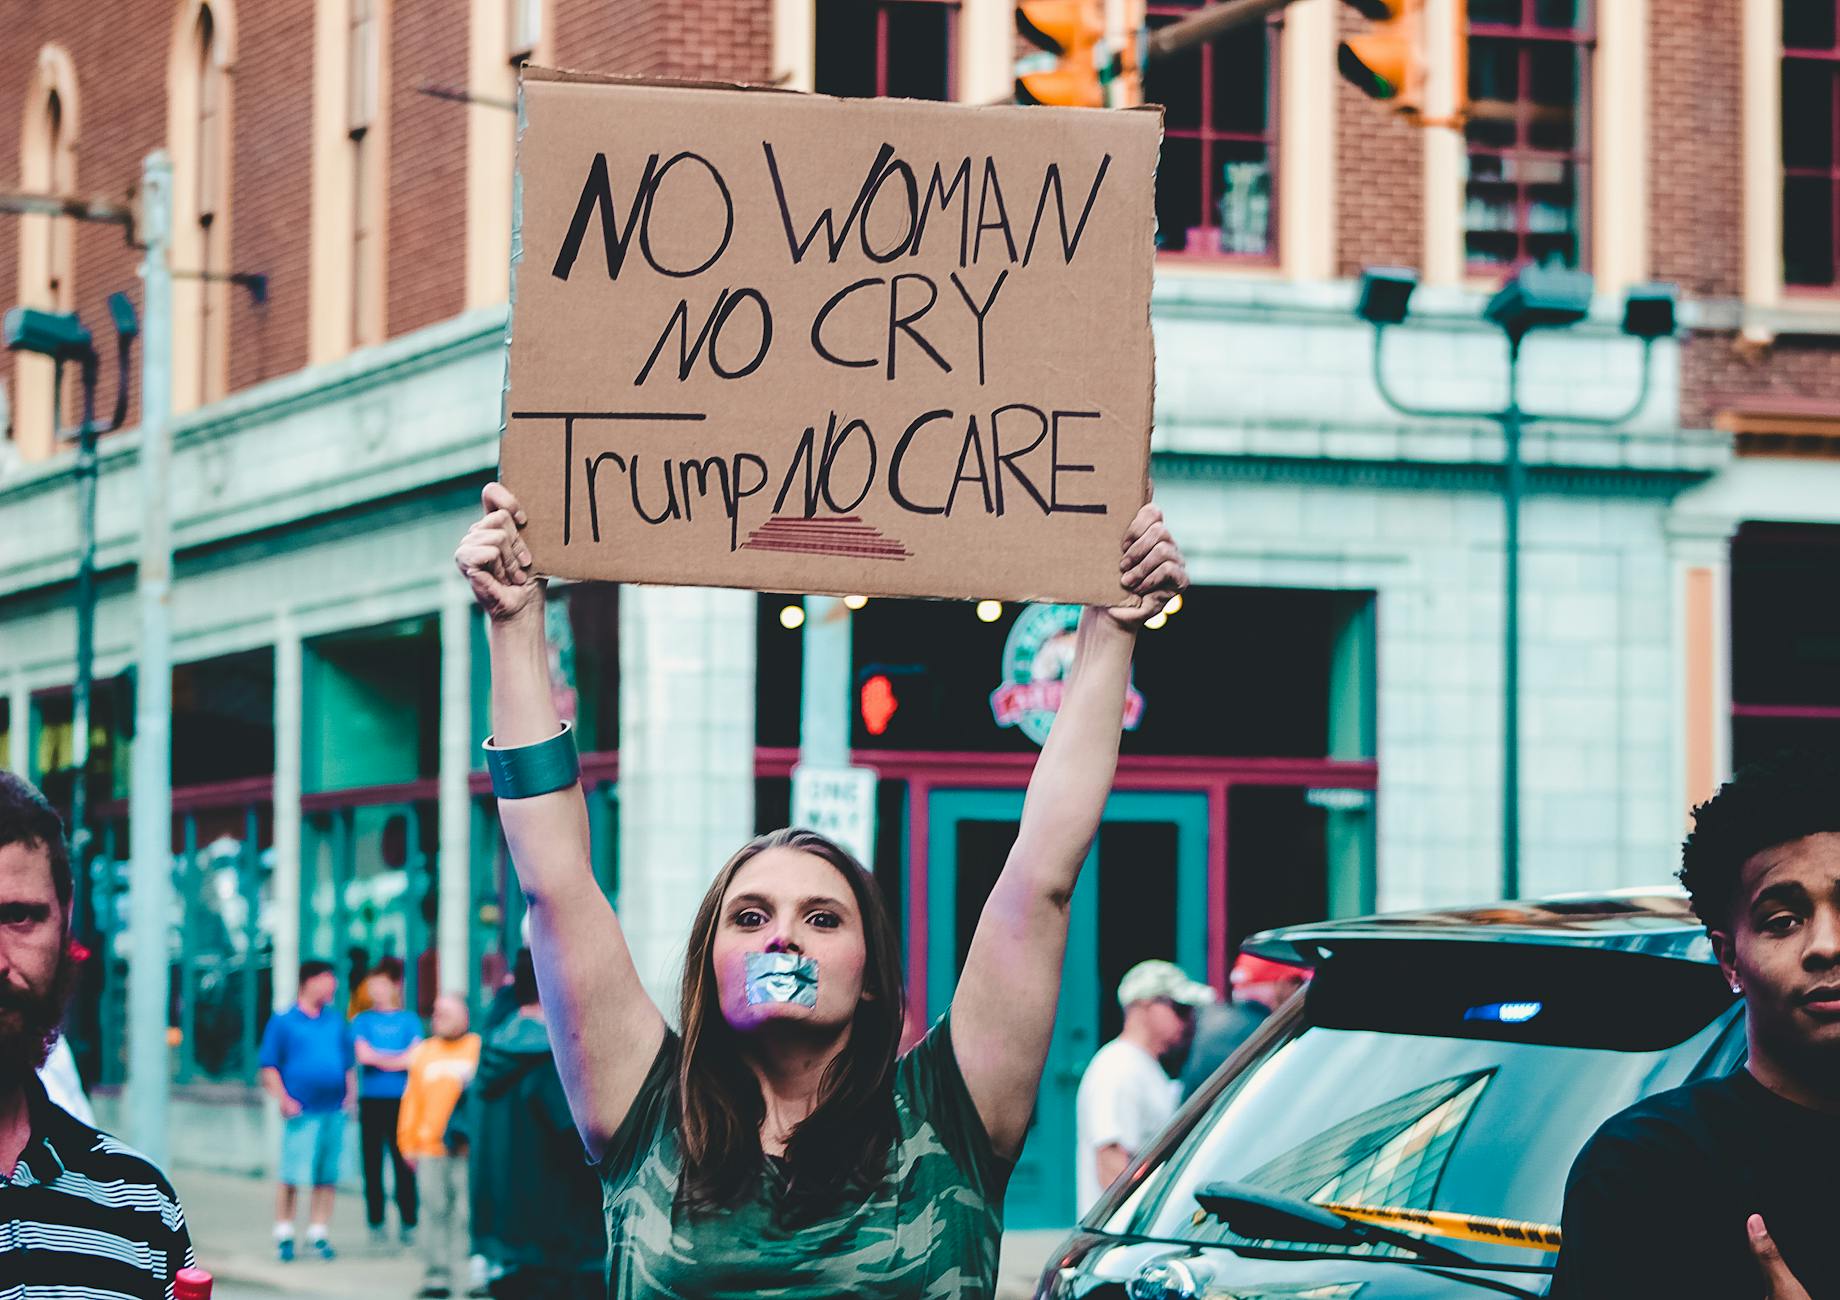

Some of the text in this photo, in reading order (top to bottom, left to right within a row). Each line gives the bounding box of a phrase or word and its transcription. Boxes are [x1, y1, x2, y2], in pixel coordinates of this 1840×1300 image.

[552, 140, 1111, 281] NO WOMAN
[633, 270, 1009, 386] NO CRY
[512, 404, 1108, 553] Trump NO CARE
